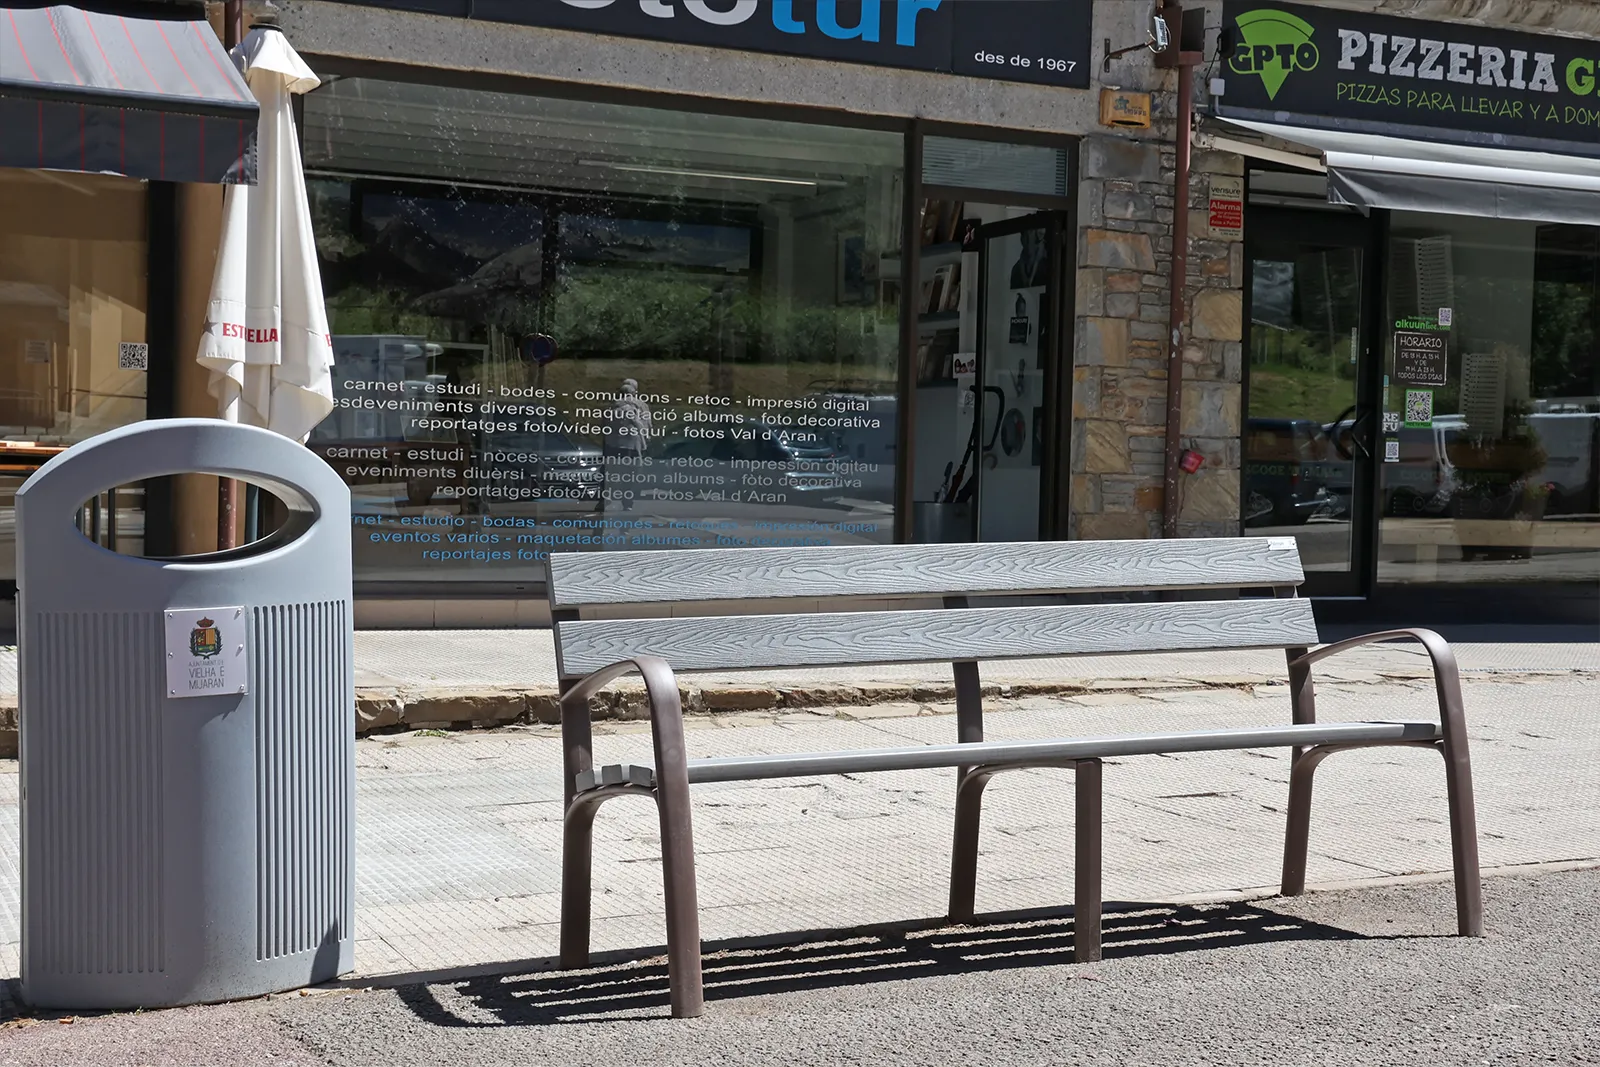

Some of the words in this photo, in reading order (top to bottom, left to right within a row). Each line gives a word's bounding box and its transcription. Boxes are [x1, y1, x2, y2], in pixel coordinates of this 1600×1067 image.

[974, 50, 1006, 65] des
[1010, 54, 1031, 69] de
[1037, 58, 1077, 73] 1967
[1228, 41, 1320, 74] GPTO
[1337, 28, 1559, 93] PIZZERIA
[1565, 57, 1600, 96] G
[1337, 82, 1401, 106] PIZZAS
[1408, 90, 1456, 113] PARA
[1461, 96, 1523, 119] LLEVAR
[1530, 104, 1541, 121] Y
[1545, 105, 1559, 123] A
[1211, 201, 1241, 211] Alarma
[1400, 336, 1442, 348] HORARIO
[344, 380, 404, 392] carnet
[424, 382, 481, 396] estudi
[500, 385, 556, 399] bodes
[574, 390, 670, 404] comunions
[688, 394, 730, 406] retoc
[747, 395, 817, 410] impresió
[822, 399, 870, 413] digital
[480, 401, 556, 416] diversos
[576, 406, 677, 421] maquetació
[683, 410, 744, 424] albums
[761, 412, 792, 426] foto
[797, 414, 880, 429] decorativa
[411, 417, 517, 434] reportatges
[524, 420, 612, 436] foto/vídeo
[618, 426, 666, 439] esquí
[684, 426, 724, 439] fotos
[730, 428, 756, 440] Val
[326, 446, 388, 460] carnet
[407, 448, 464, 462] estudi
[483, 450, 538, 464] nòces
[556, 454, 652, 467] comunions
[671, 456, 714, 468] retoc
[825, 460, 878, 474] digitau
[346, 464, 456, 479] eveniments
[463, 466, 524, 481] diuèrsi
[543, 471, 657, 485] maquetacion
[663, 472, 724, 484] albums
[742, 474, 773, 486] fòto
[778, 476, 862, 488] decorativa
[436, 483, 542, 500] reportatges
[652, 488, 694, 501] fotos
[700, 490, 726, 502] Val
[352, 514, 382, 525] net
[401, 514, 464, 528] estudio
[483, 516, 536, 528] bodas
[553, 518, 653, 530] comuniones
[670, 520, 738, 534] retoques
[755, 520, 830, 534] impresión
[834, 521, 878, 534] digital
[370, 532, 440, 544] eventos
[446, 532, 500, 544] varios
[518, 533, 626, 548] maquetación
[632, 534, 700, 546] albumes
[716, 536, 747, 546] foto
[751, 536, 831, 546] decorativa
[422, 548, 513, 562] reportajes
[220, 666, 224, 676] E
